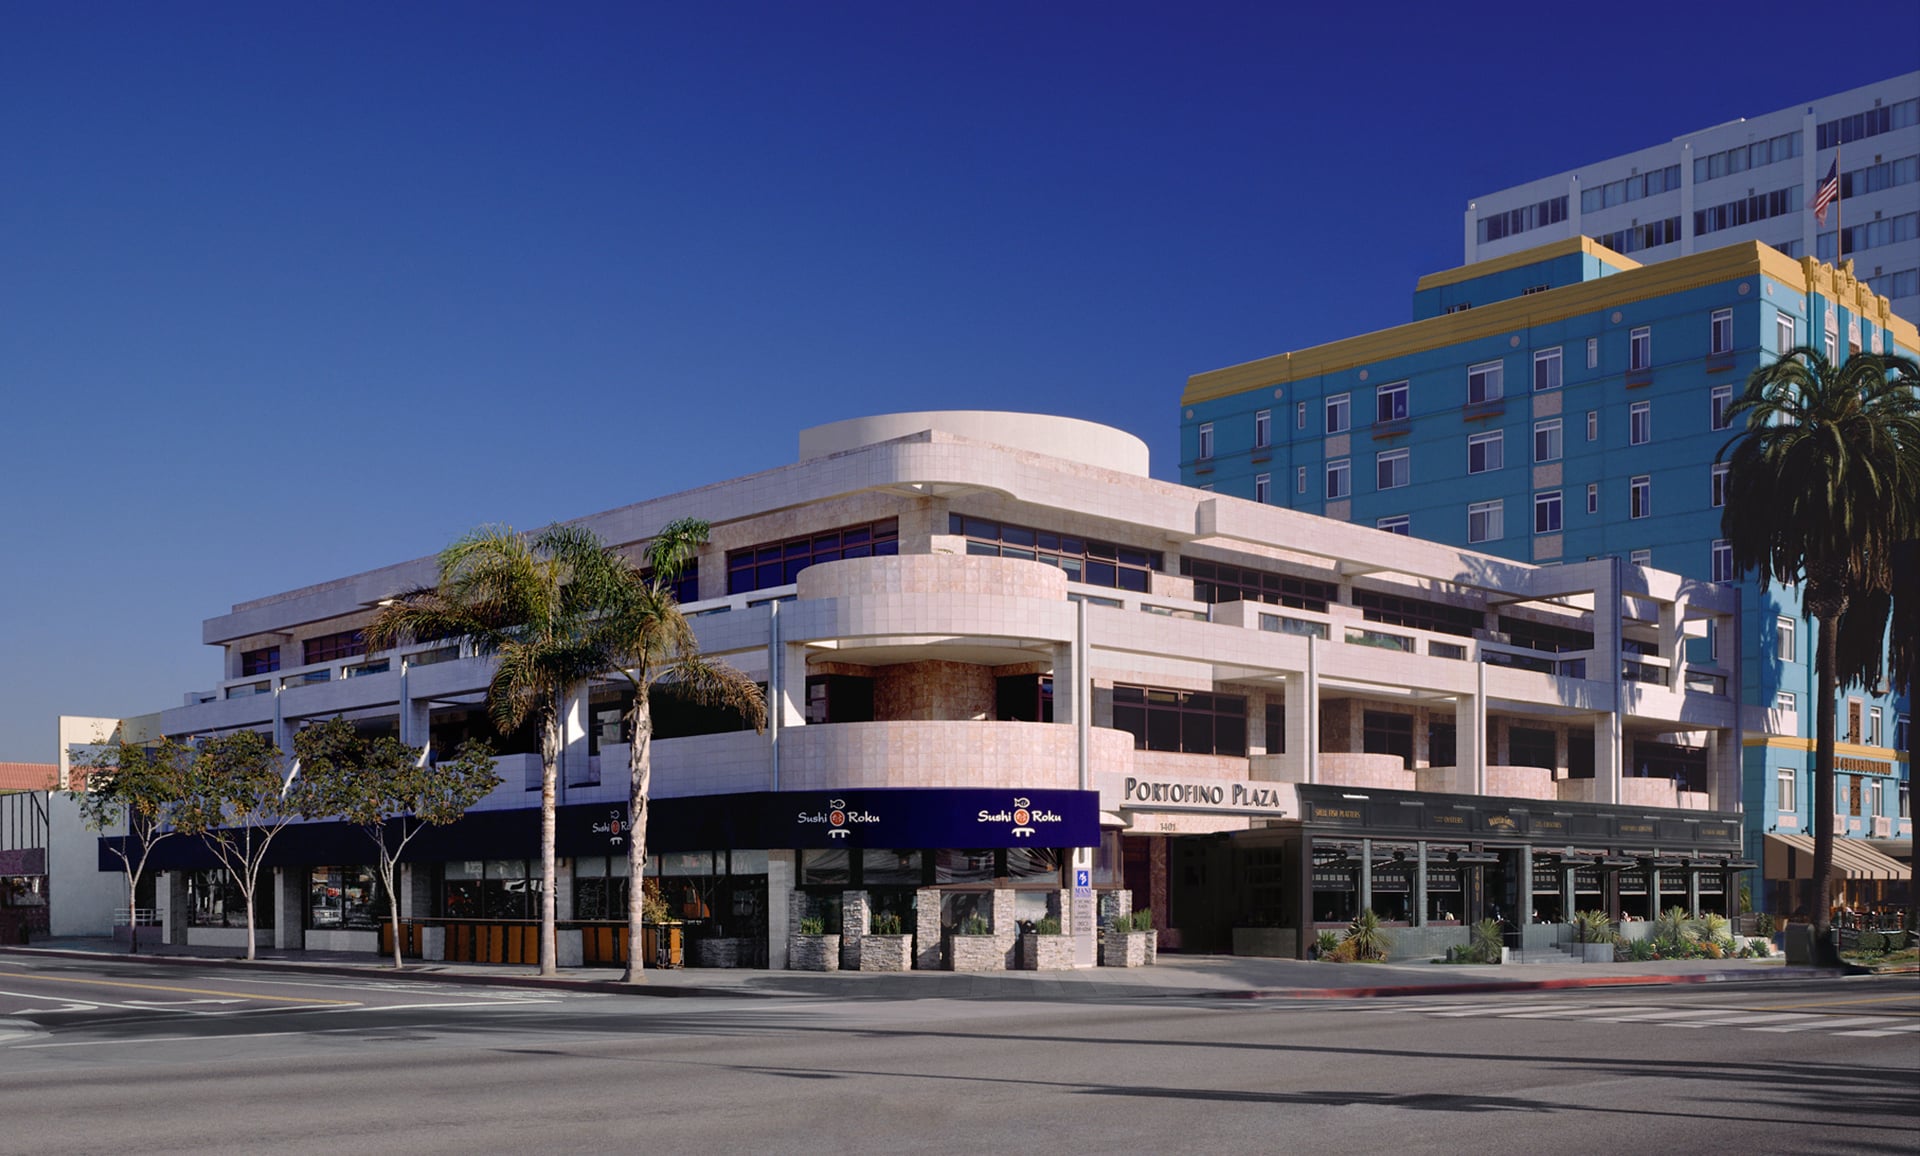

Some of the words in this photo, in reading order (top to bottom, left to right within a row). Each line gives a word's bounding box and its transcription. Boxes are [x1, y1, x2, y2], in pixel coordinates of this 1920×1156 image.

[1124, 777, 1224, 805] PORTOFINO
[1231, 783, 1280, 808] PLAZA
[797, 811, 828, 824] Sushi
[847, 810, 881, 823] Roku
[977, 809, 1012, 823] Sushi
[1031, 809, 1062, 823] Roku
[592, 821, 610, 833] Sushi
[620, 820, 631, 832] Ro
[1160, 822, 1177, 832] 1401
